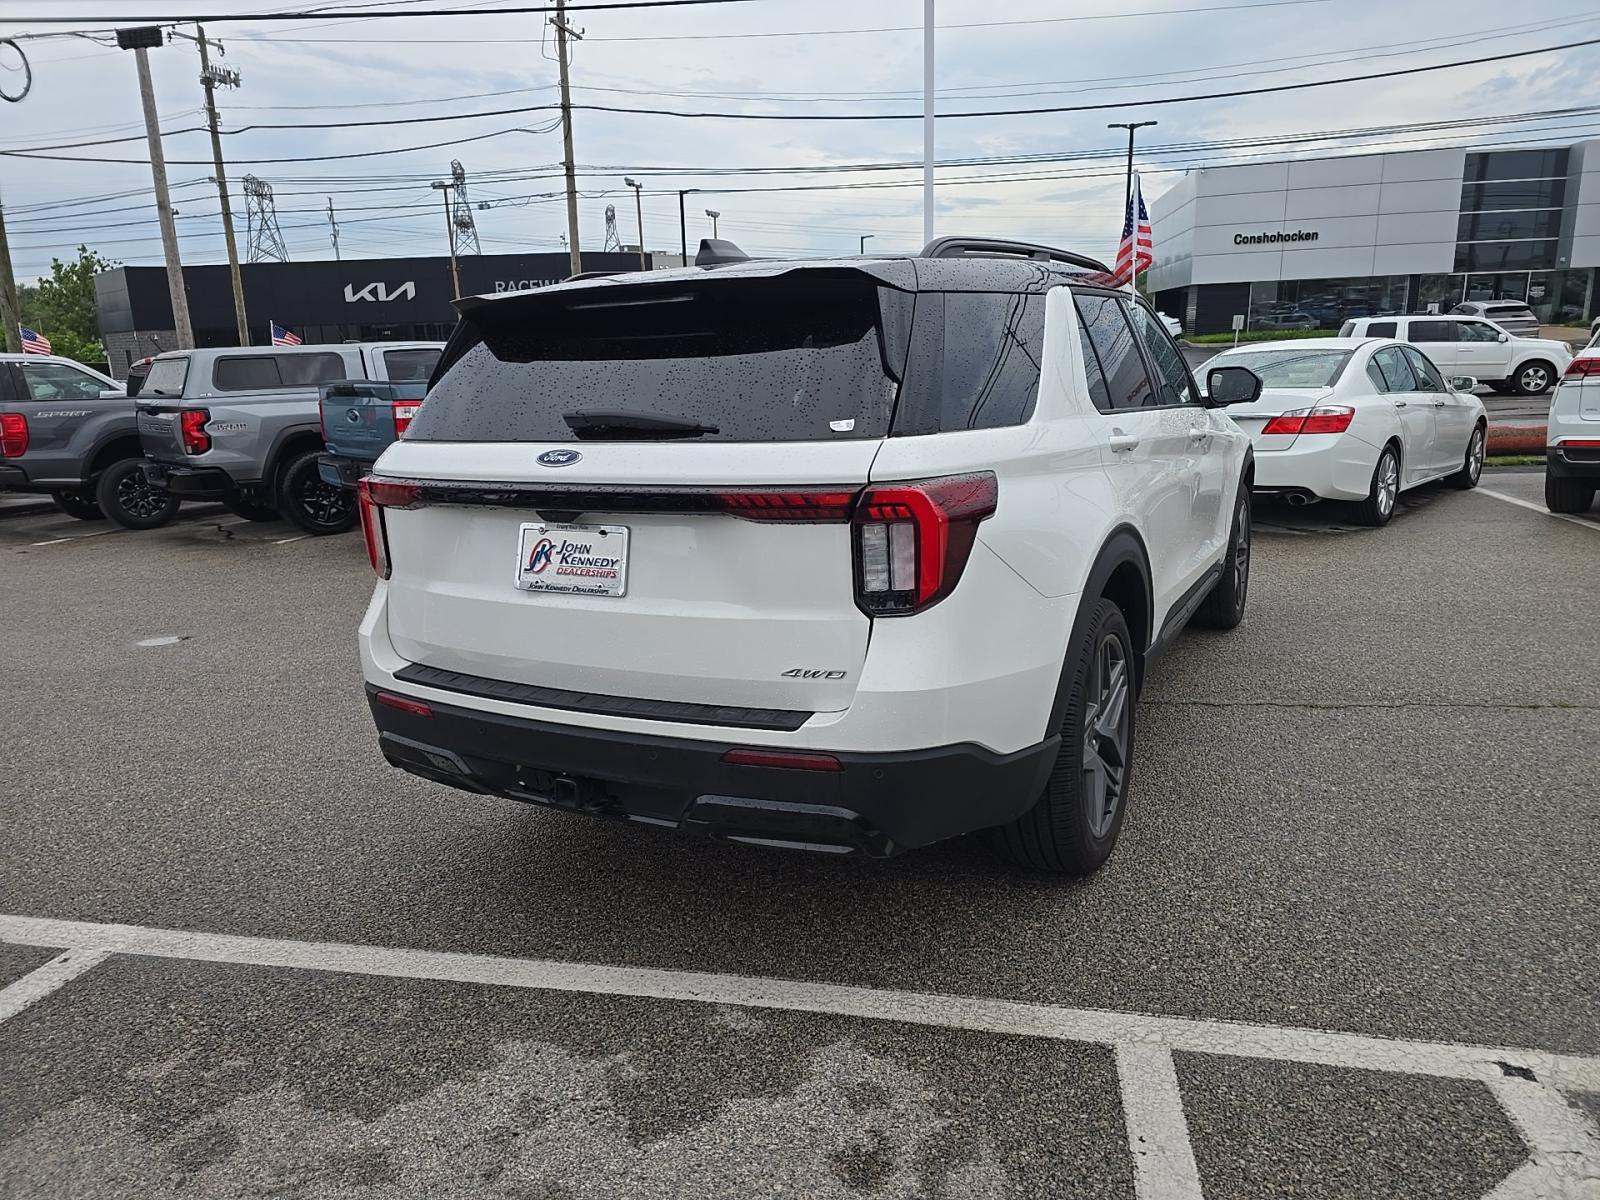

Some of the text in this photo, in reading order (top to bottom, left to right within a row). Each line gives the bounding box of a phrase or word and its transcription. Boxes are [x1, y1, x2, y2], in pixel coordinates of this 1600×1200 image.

[1233, 230, 1319, 245] Conshohocken
[343, 281, 416, 302] KIA
[494, 279, 564, 294] RACEW
[34, 410, 92, 419] SPORT
[556, 540, 592, 555] JOHN
[560, 552, 619, 568] KENNEDY
[556, 567, 618, 579] DEALERSHIPS
[781, 668, 847, 680] 4WD
